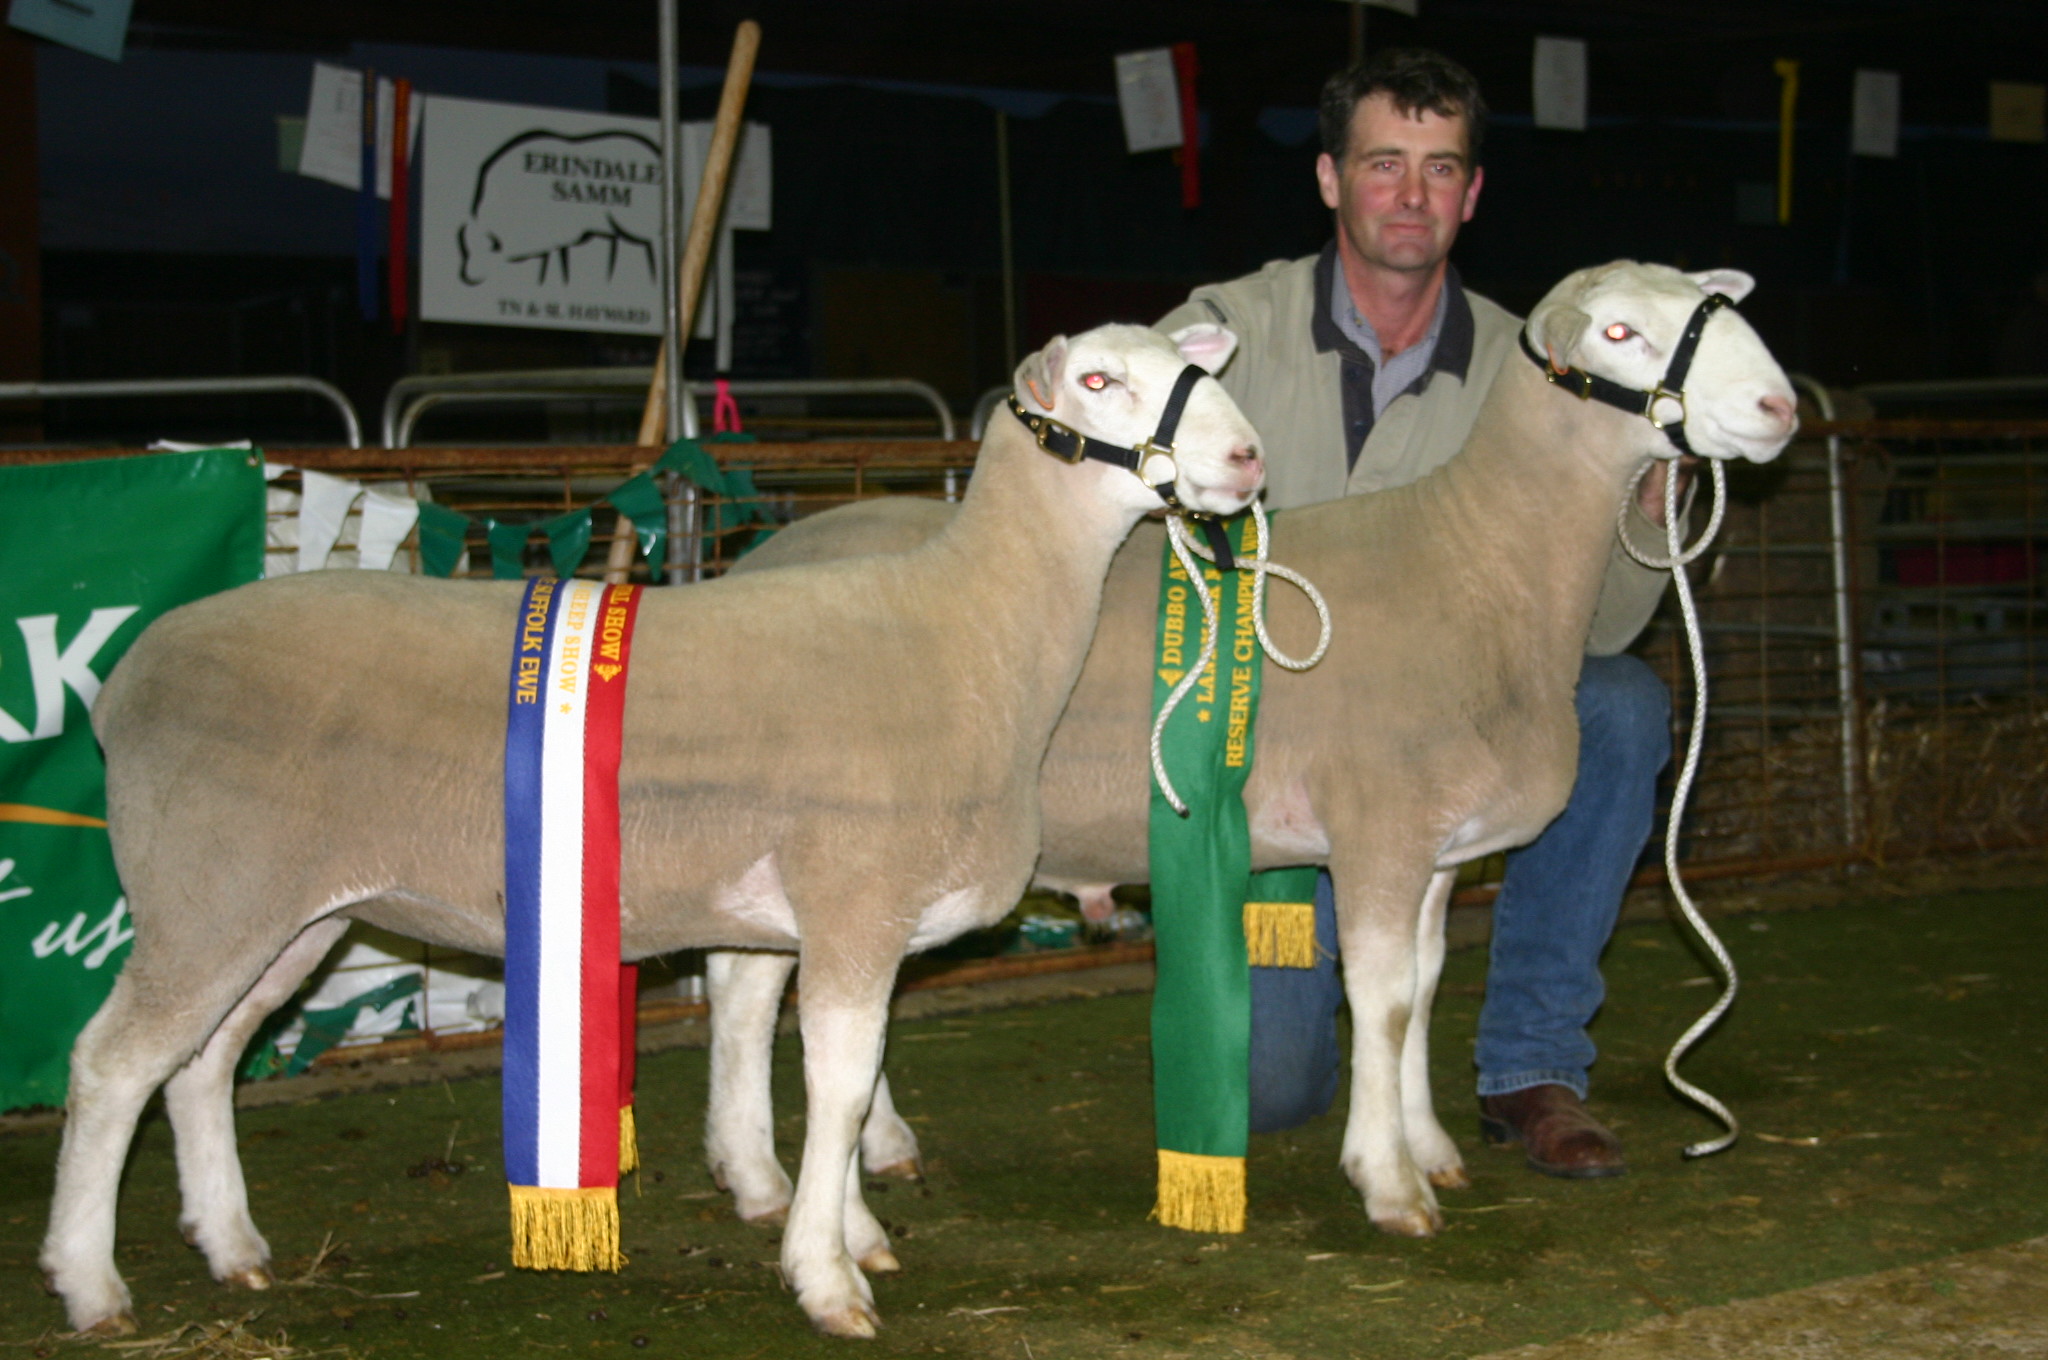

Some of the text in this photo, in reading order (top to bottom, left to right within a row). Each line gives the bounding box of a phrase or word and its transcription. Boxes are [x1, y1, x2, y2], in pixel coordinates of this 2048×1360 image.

[524, 151, 662, 185] ERINDALE
[552, 180, 632, 207] SAMM
[522, 583, 554, 652] SUFFOLK
[600, 606, 628, 662] SHOW
[1162, 585, 1188, 665] DUBBO
[0, 605, 141, 743] K
[515, 656, 541, 705] EWE
[558, 635, 581, 694] SHOW
[1225, 666, 1252, 768] RESERVE
